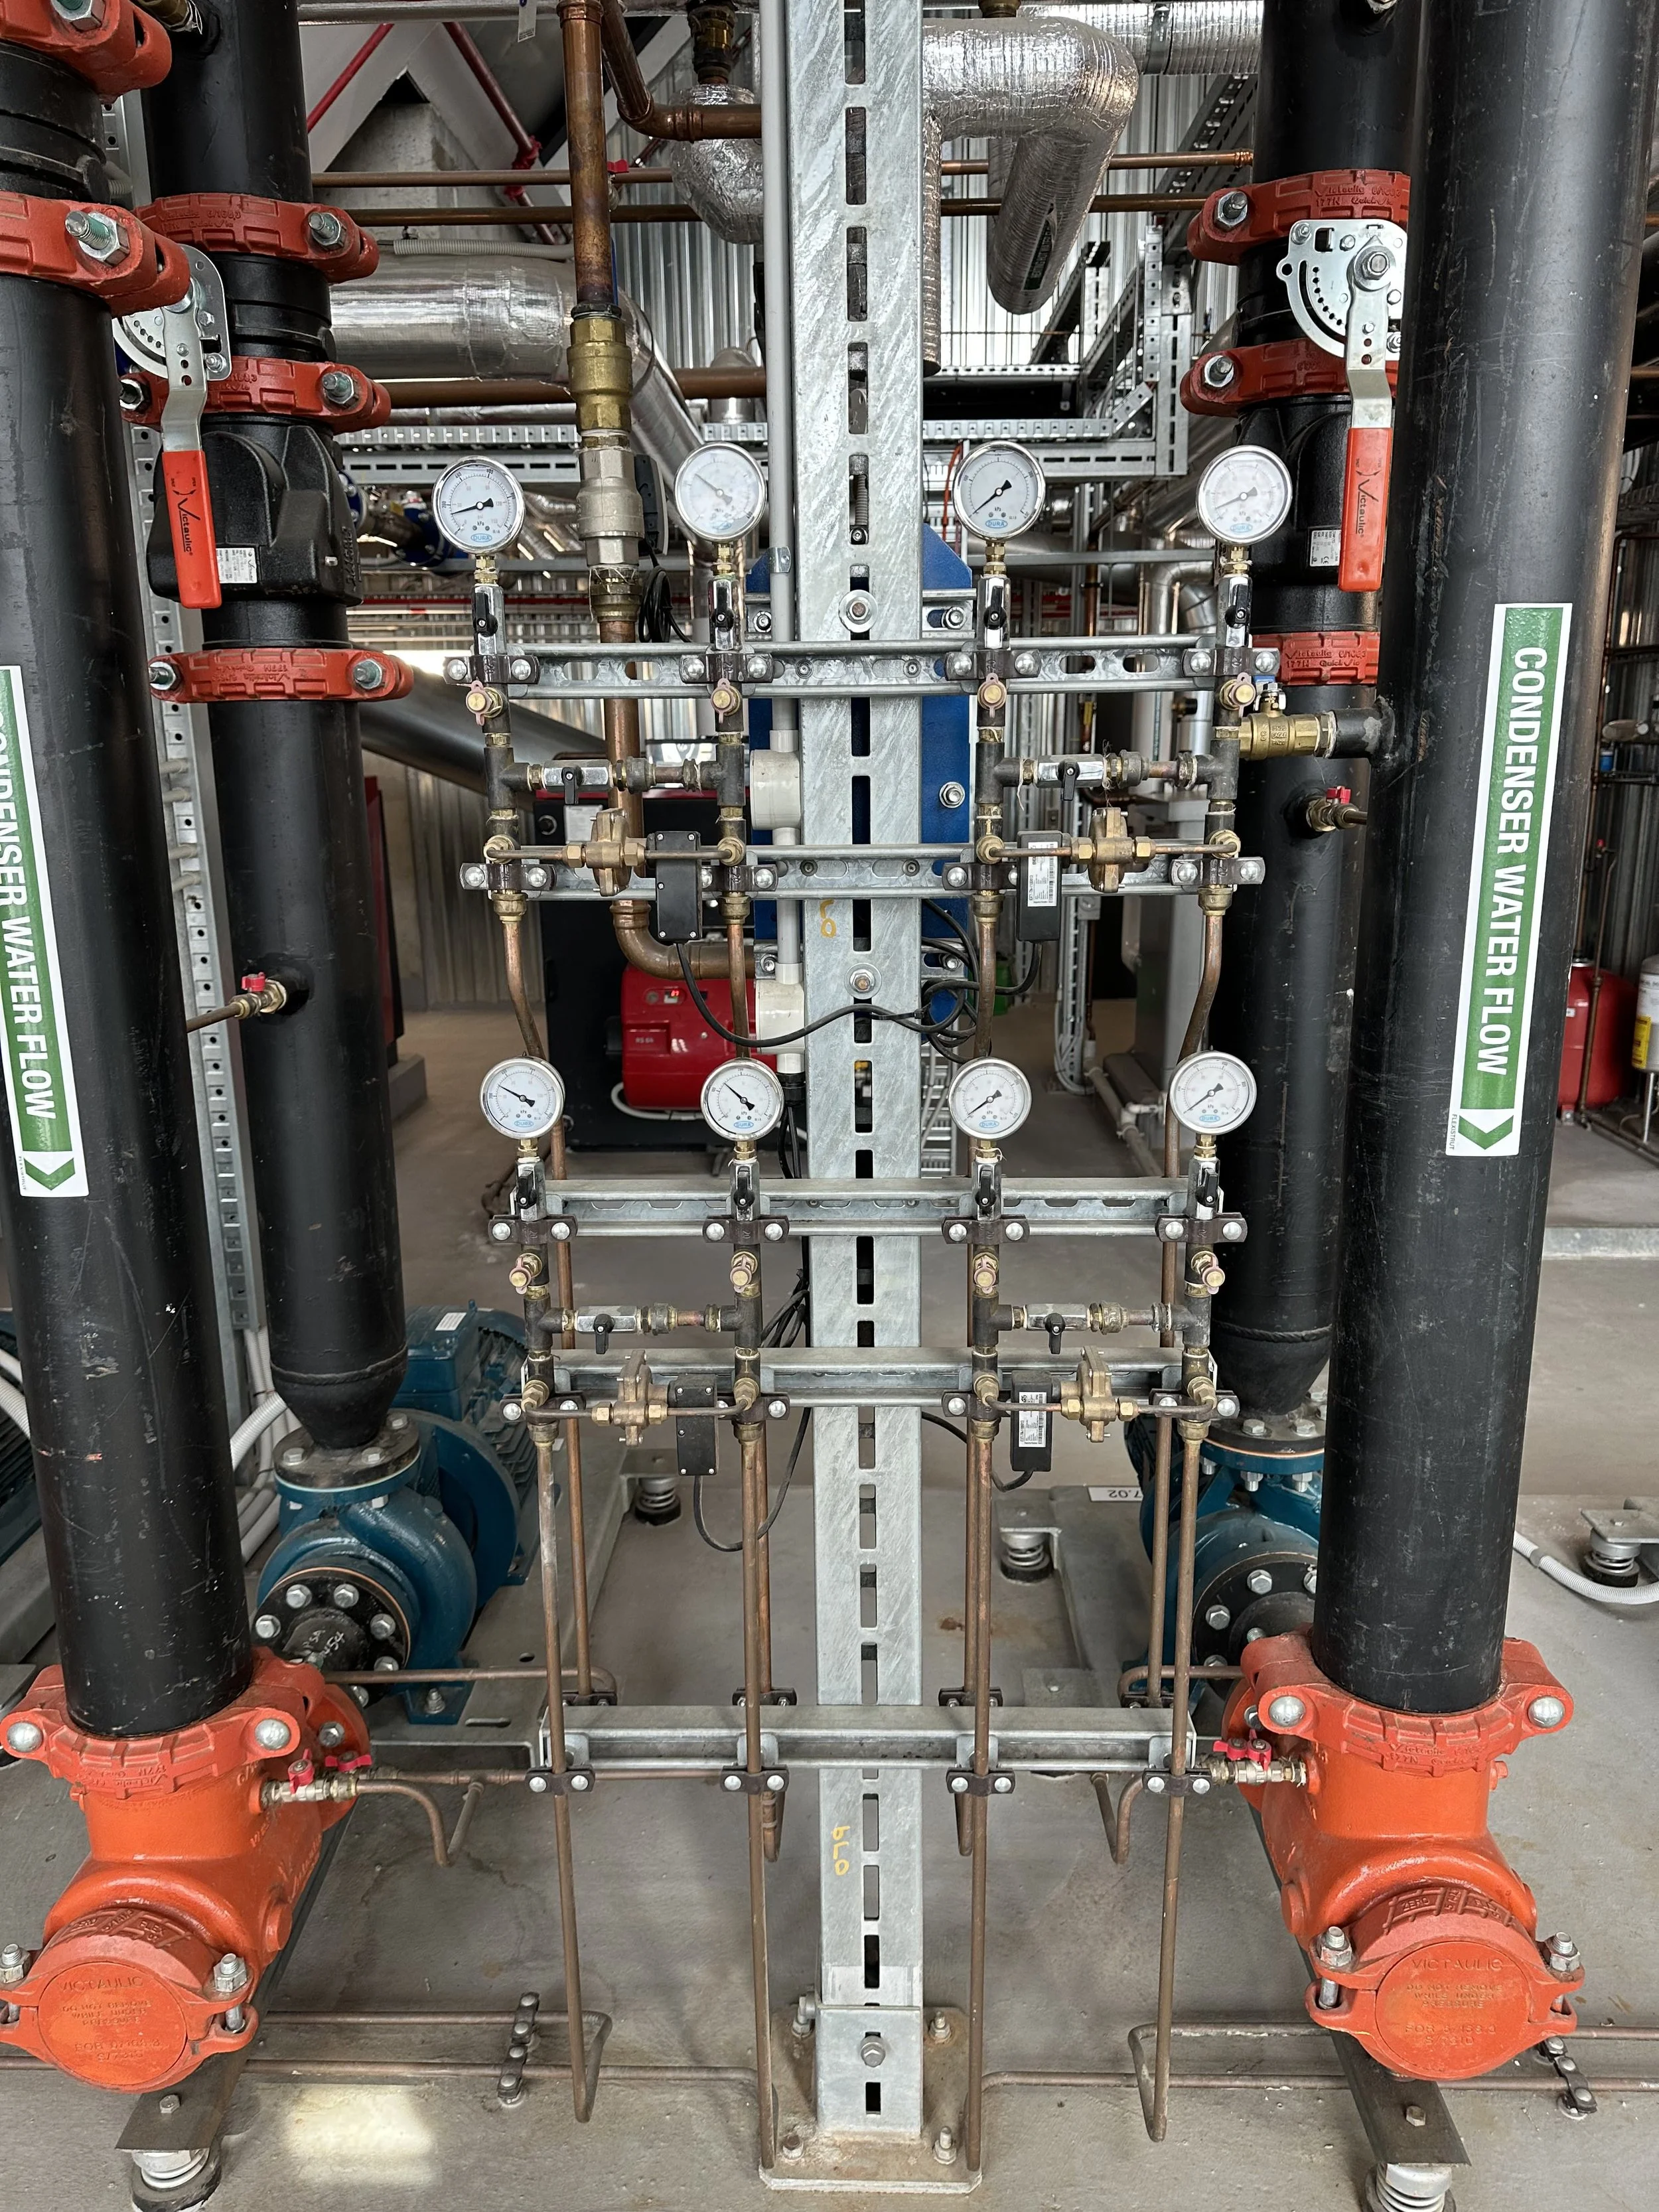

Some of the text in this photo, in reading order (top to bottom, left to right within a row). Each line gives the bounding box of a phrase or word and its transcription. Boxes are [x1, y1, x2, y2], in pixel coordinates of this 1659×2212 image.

[177, 498, 201, 553] Victaulic
[1358, 479, 1380, 535] Victaulic
[1477, 647, 1548, 1075] CONDENSER WATER FLOW
[2, 916, 43, 1025] WATER
[17, 1035, 56, 1120] FLOW
[60, 1976, 144, 1992] VICTAULIC
[1411, 1958, 1502, 1971] VICTAULIC
